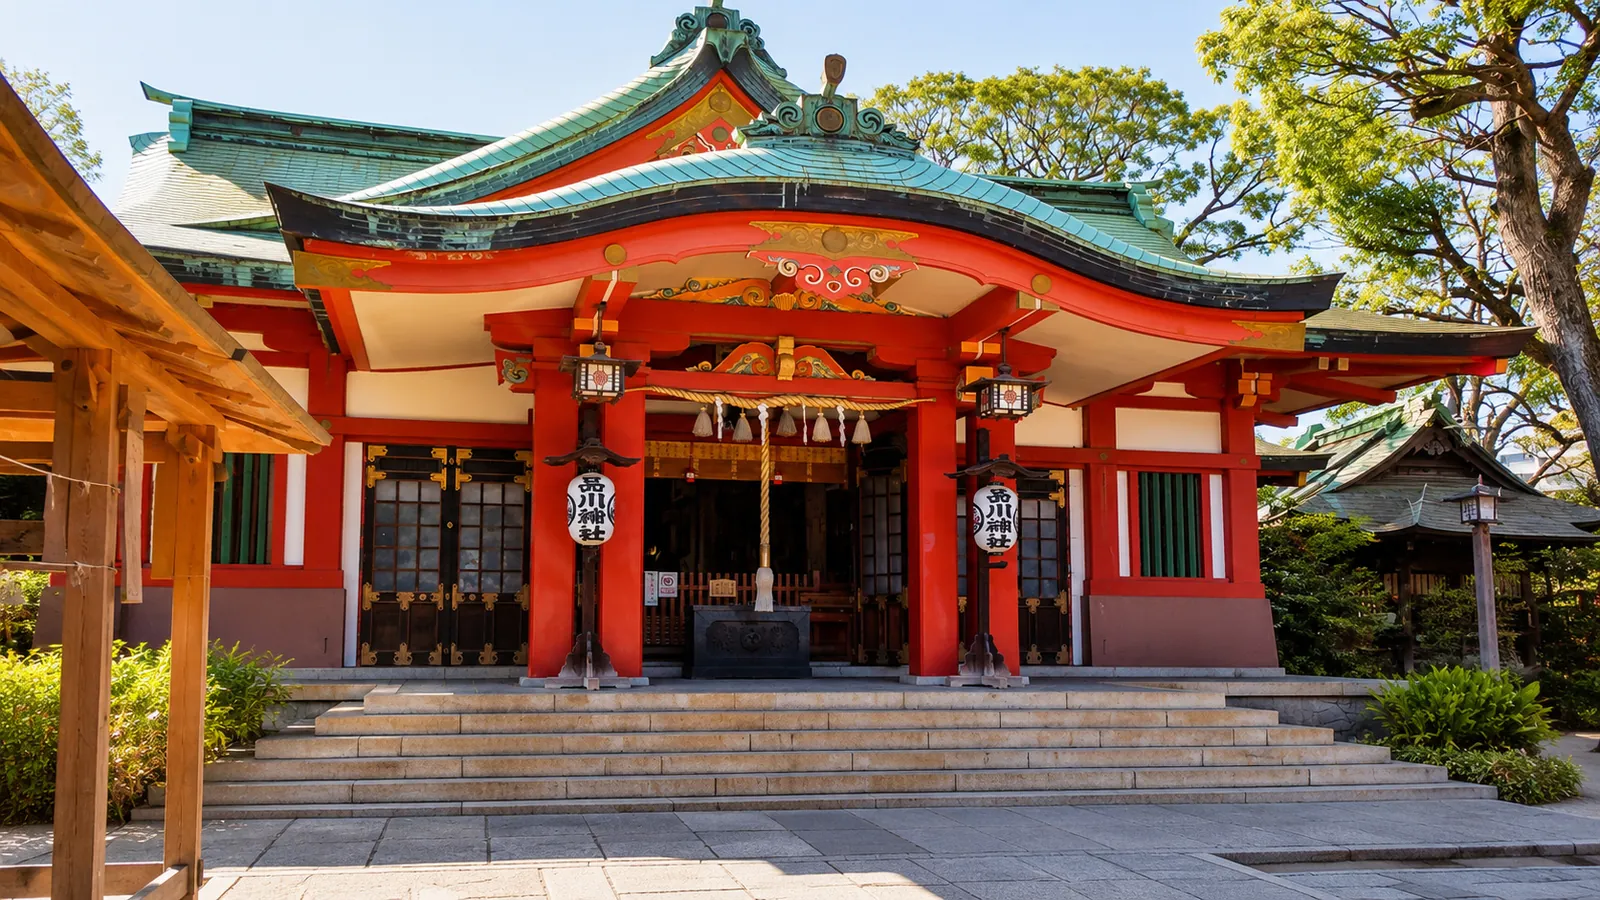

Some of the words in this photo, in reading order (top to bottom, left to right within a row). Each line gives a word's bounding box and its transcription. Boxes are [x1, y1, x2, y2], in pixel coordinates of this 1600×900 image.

[578, 476, 605, 541] 品川神社
[986, 488, 1012, 548] 品川神社
